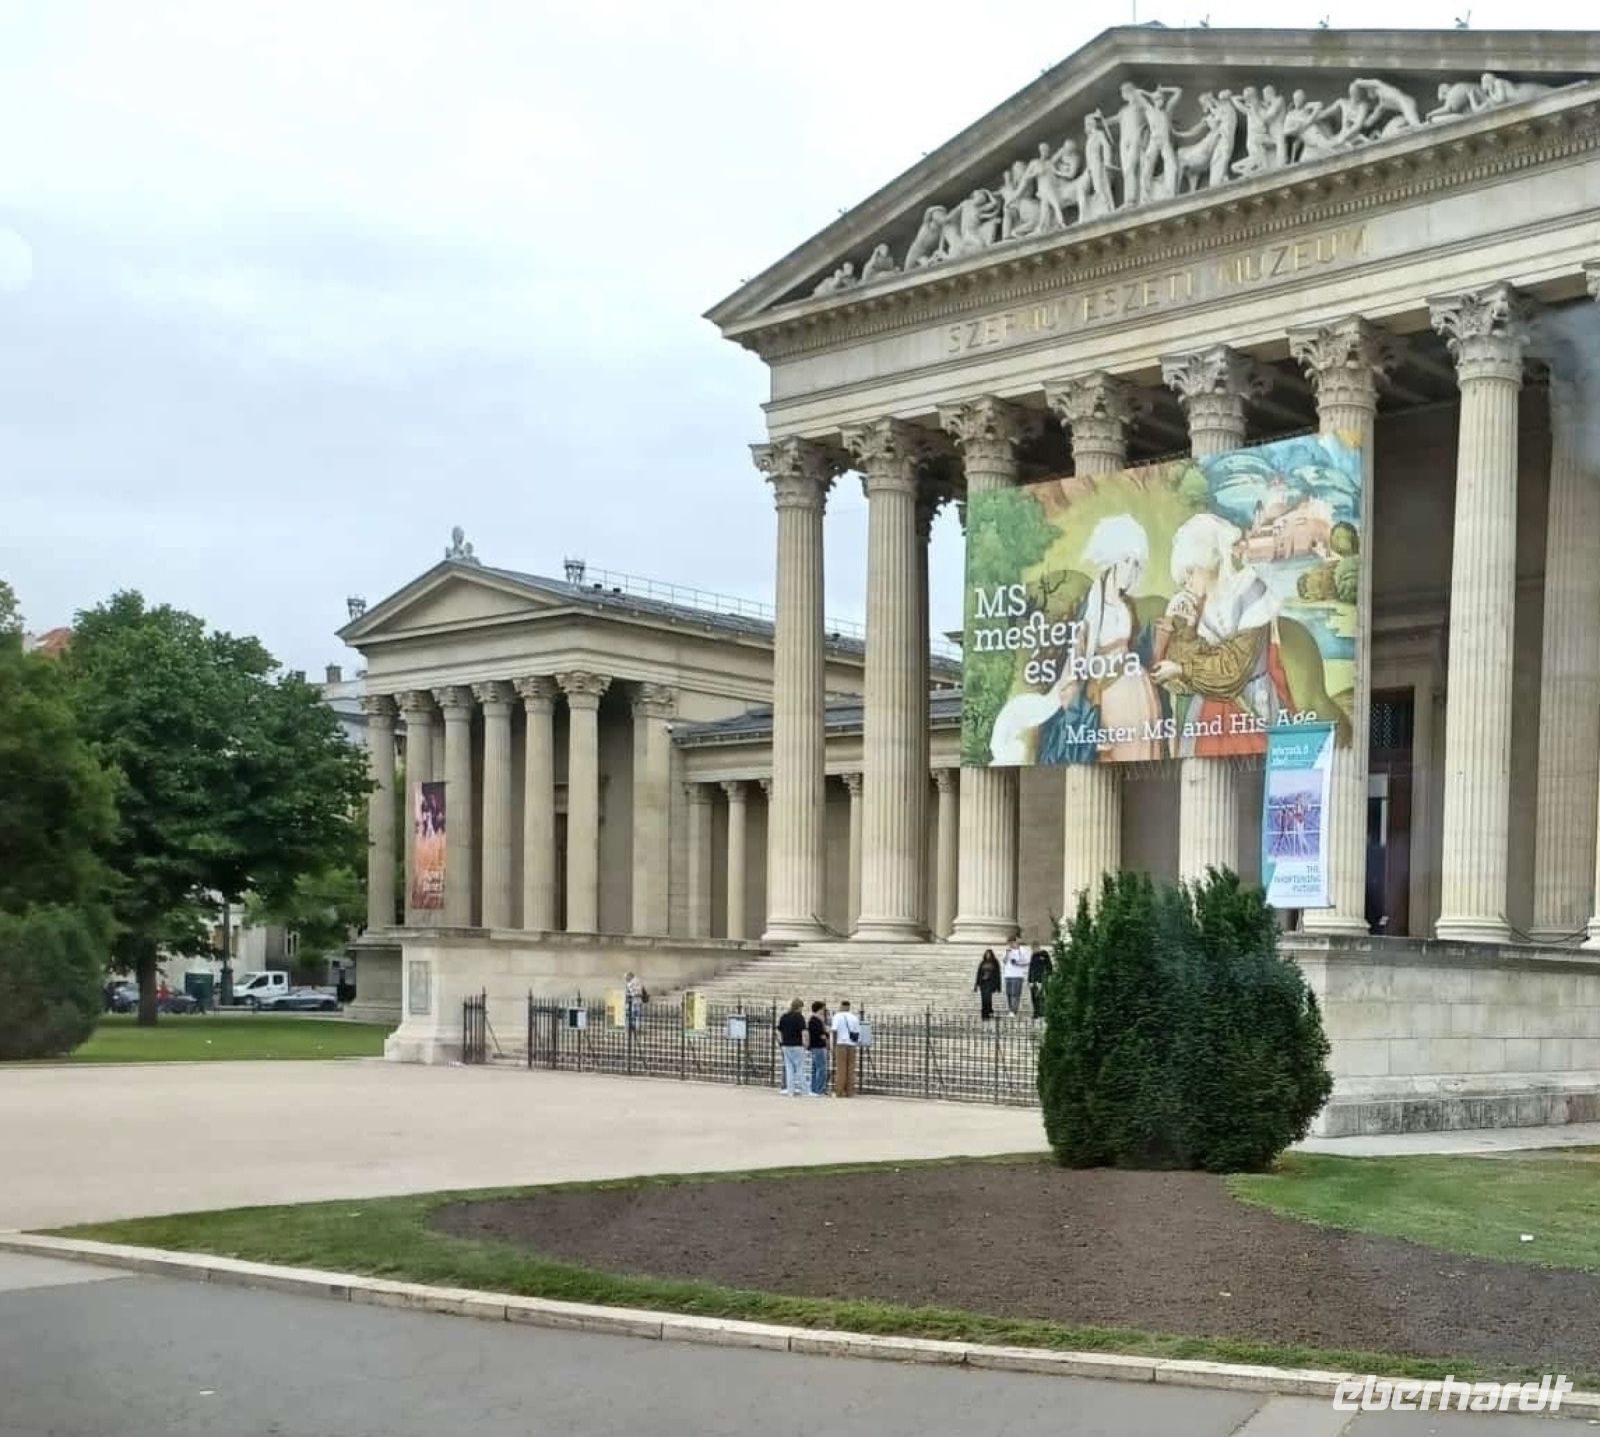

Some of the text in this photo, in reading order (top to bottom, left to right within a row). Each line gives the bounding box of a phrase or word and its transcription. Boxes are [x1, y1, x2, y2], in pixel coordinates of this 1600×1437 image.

[974, 584, 1027, 618] MS
[973, 611, 1086, 651] mester
[1024, 648, 1141, 684] és kora
[1066, 724, 1136, 745] Master
[1142, 718, 1177, 740] MS
[1182, 715, 1223, 738] and
[1229, 712, 1269, 734] His
